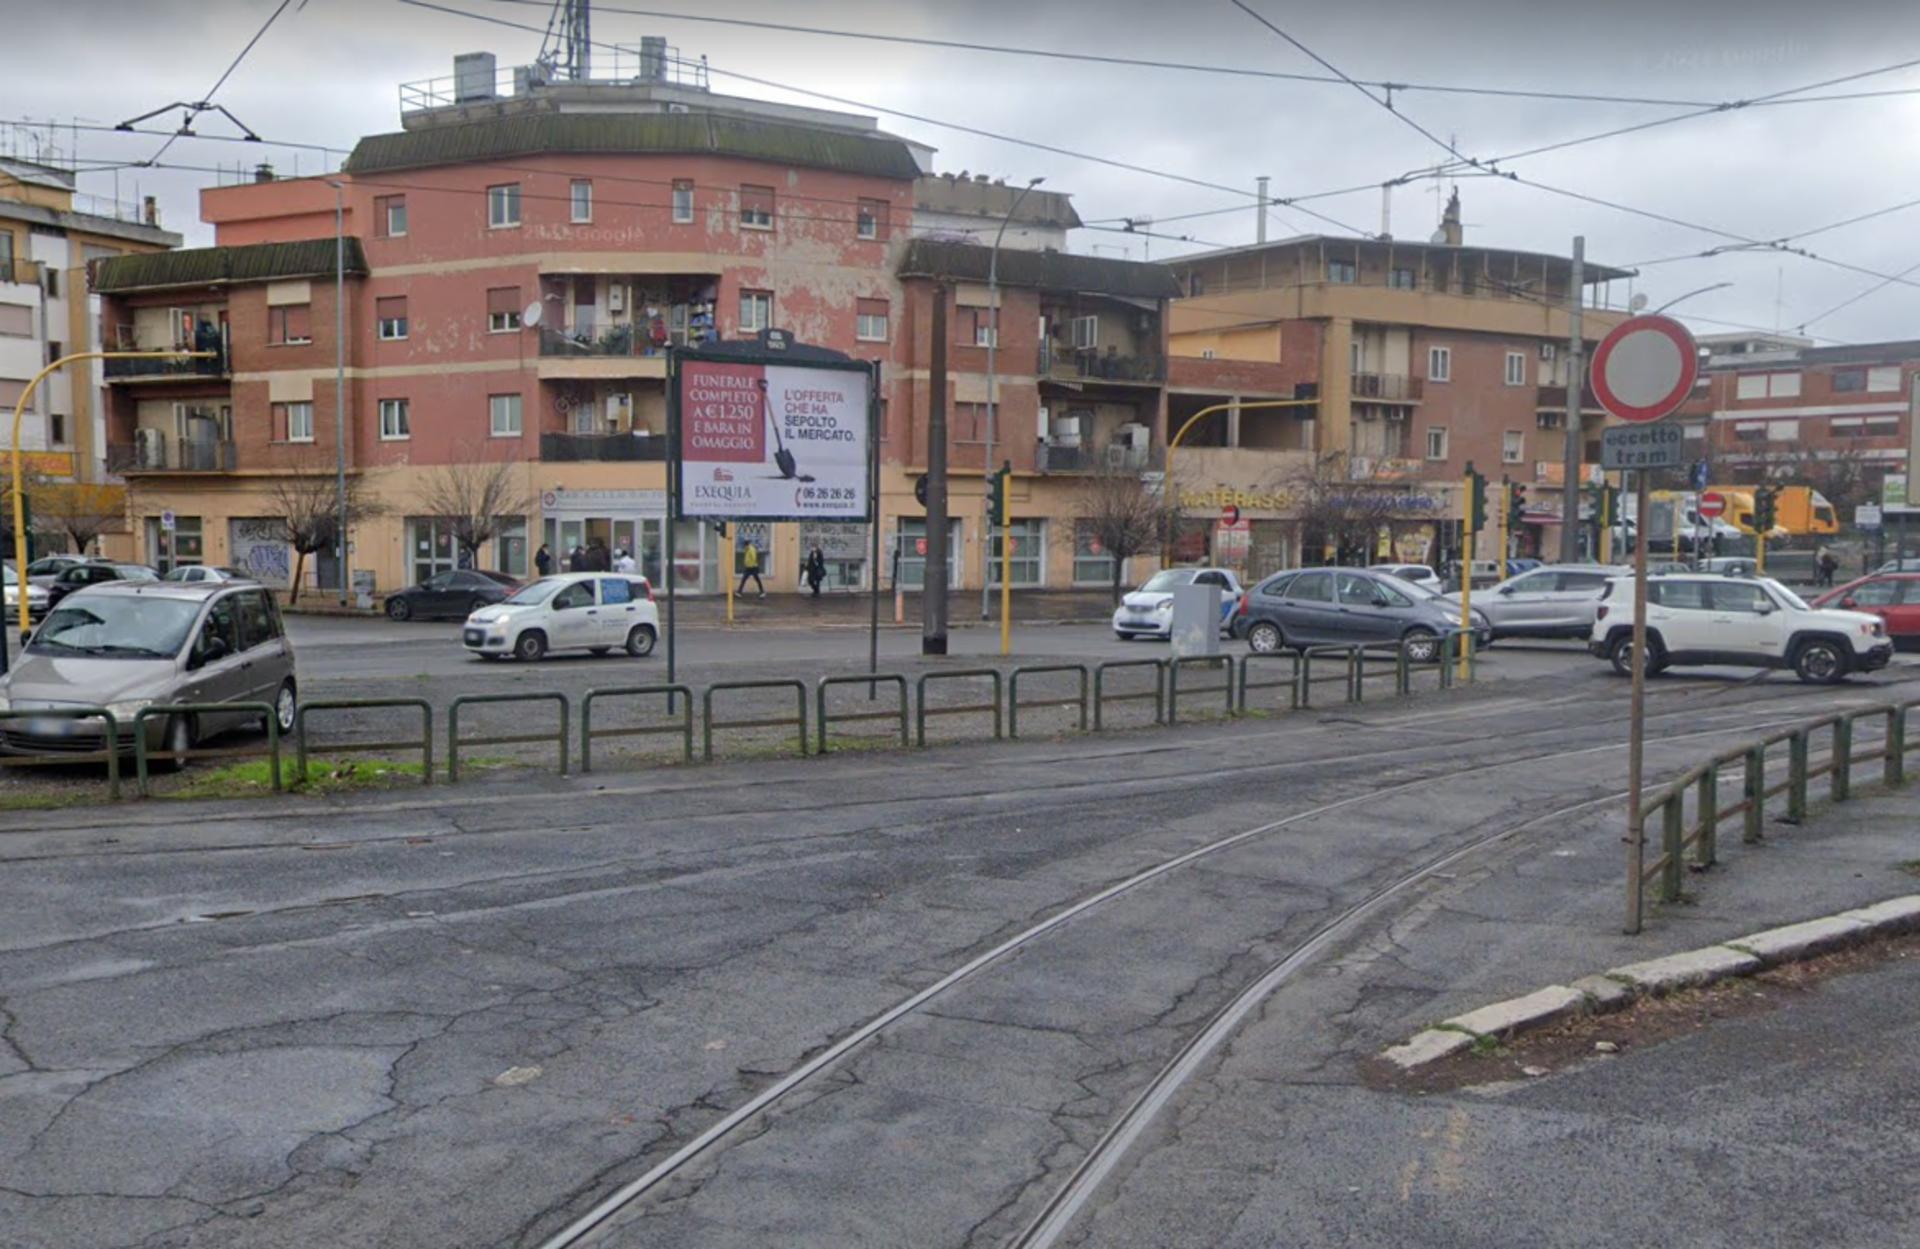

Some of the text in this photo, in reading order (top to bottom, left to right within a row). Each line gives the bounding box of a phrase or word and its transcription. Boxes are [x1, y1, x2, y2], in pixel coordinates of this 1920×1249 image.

[693, 374, 754, 389] FUNERALE
[689, 388, 758, 404] COMPLETO
[784, 389, 844, 403] L'OFFERTA
[784, 402, 828, 415] CHE HA
[694, 420, 752, 434] E BARA IN
[784, 414, 837, 428] SEPOLTO
[784, 428, 856, 442] IL MERCATO.
[1606, 429, 1678, 446] eccetto
[1616, 450, 1667, 463] tram
[694, 485, 752, 501] EXEQUIA
[802, 487, 856, 500] 06 26 26 26
